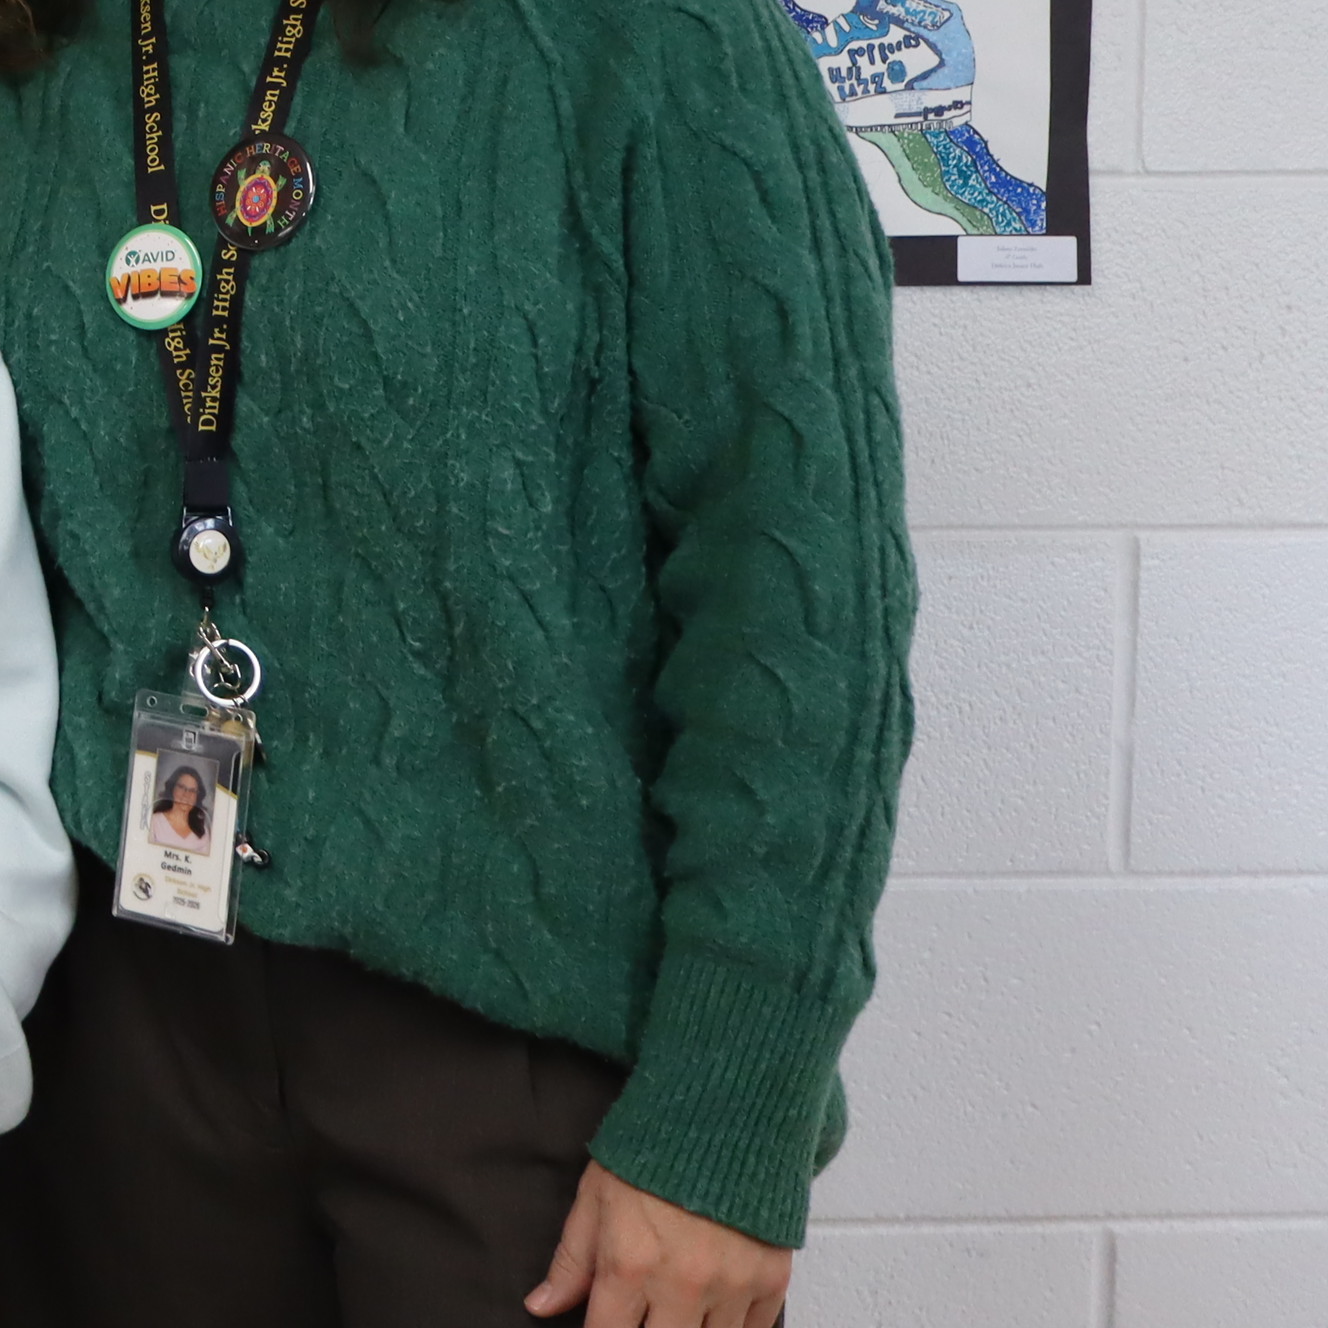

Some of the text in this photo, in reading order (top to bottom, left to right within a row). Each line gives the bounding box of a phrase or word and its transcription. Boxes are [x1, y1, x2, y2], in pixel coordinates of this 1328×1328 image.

[140, 37, 157, 60] Jr.
[141, 61, 160, 109] High
[144, 111, 165, 174] School
[216, 143, 304, 229] HISPANIC HERITAGE MONTH
[142, 250, 175, 264] AVID
[110, 267, 197, 306] VIBES
[160, 861, 192, 876] Gedmin
[164, 850, 192, 864] Mrs. K.
